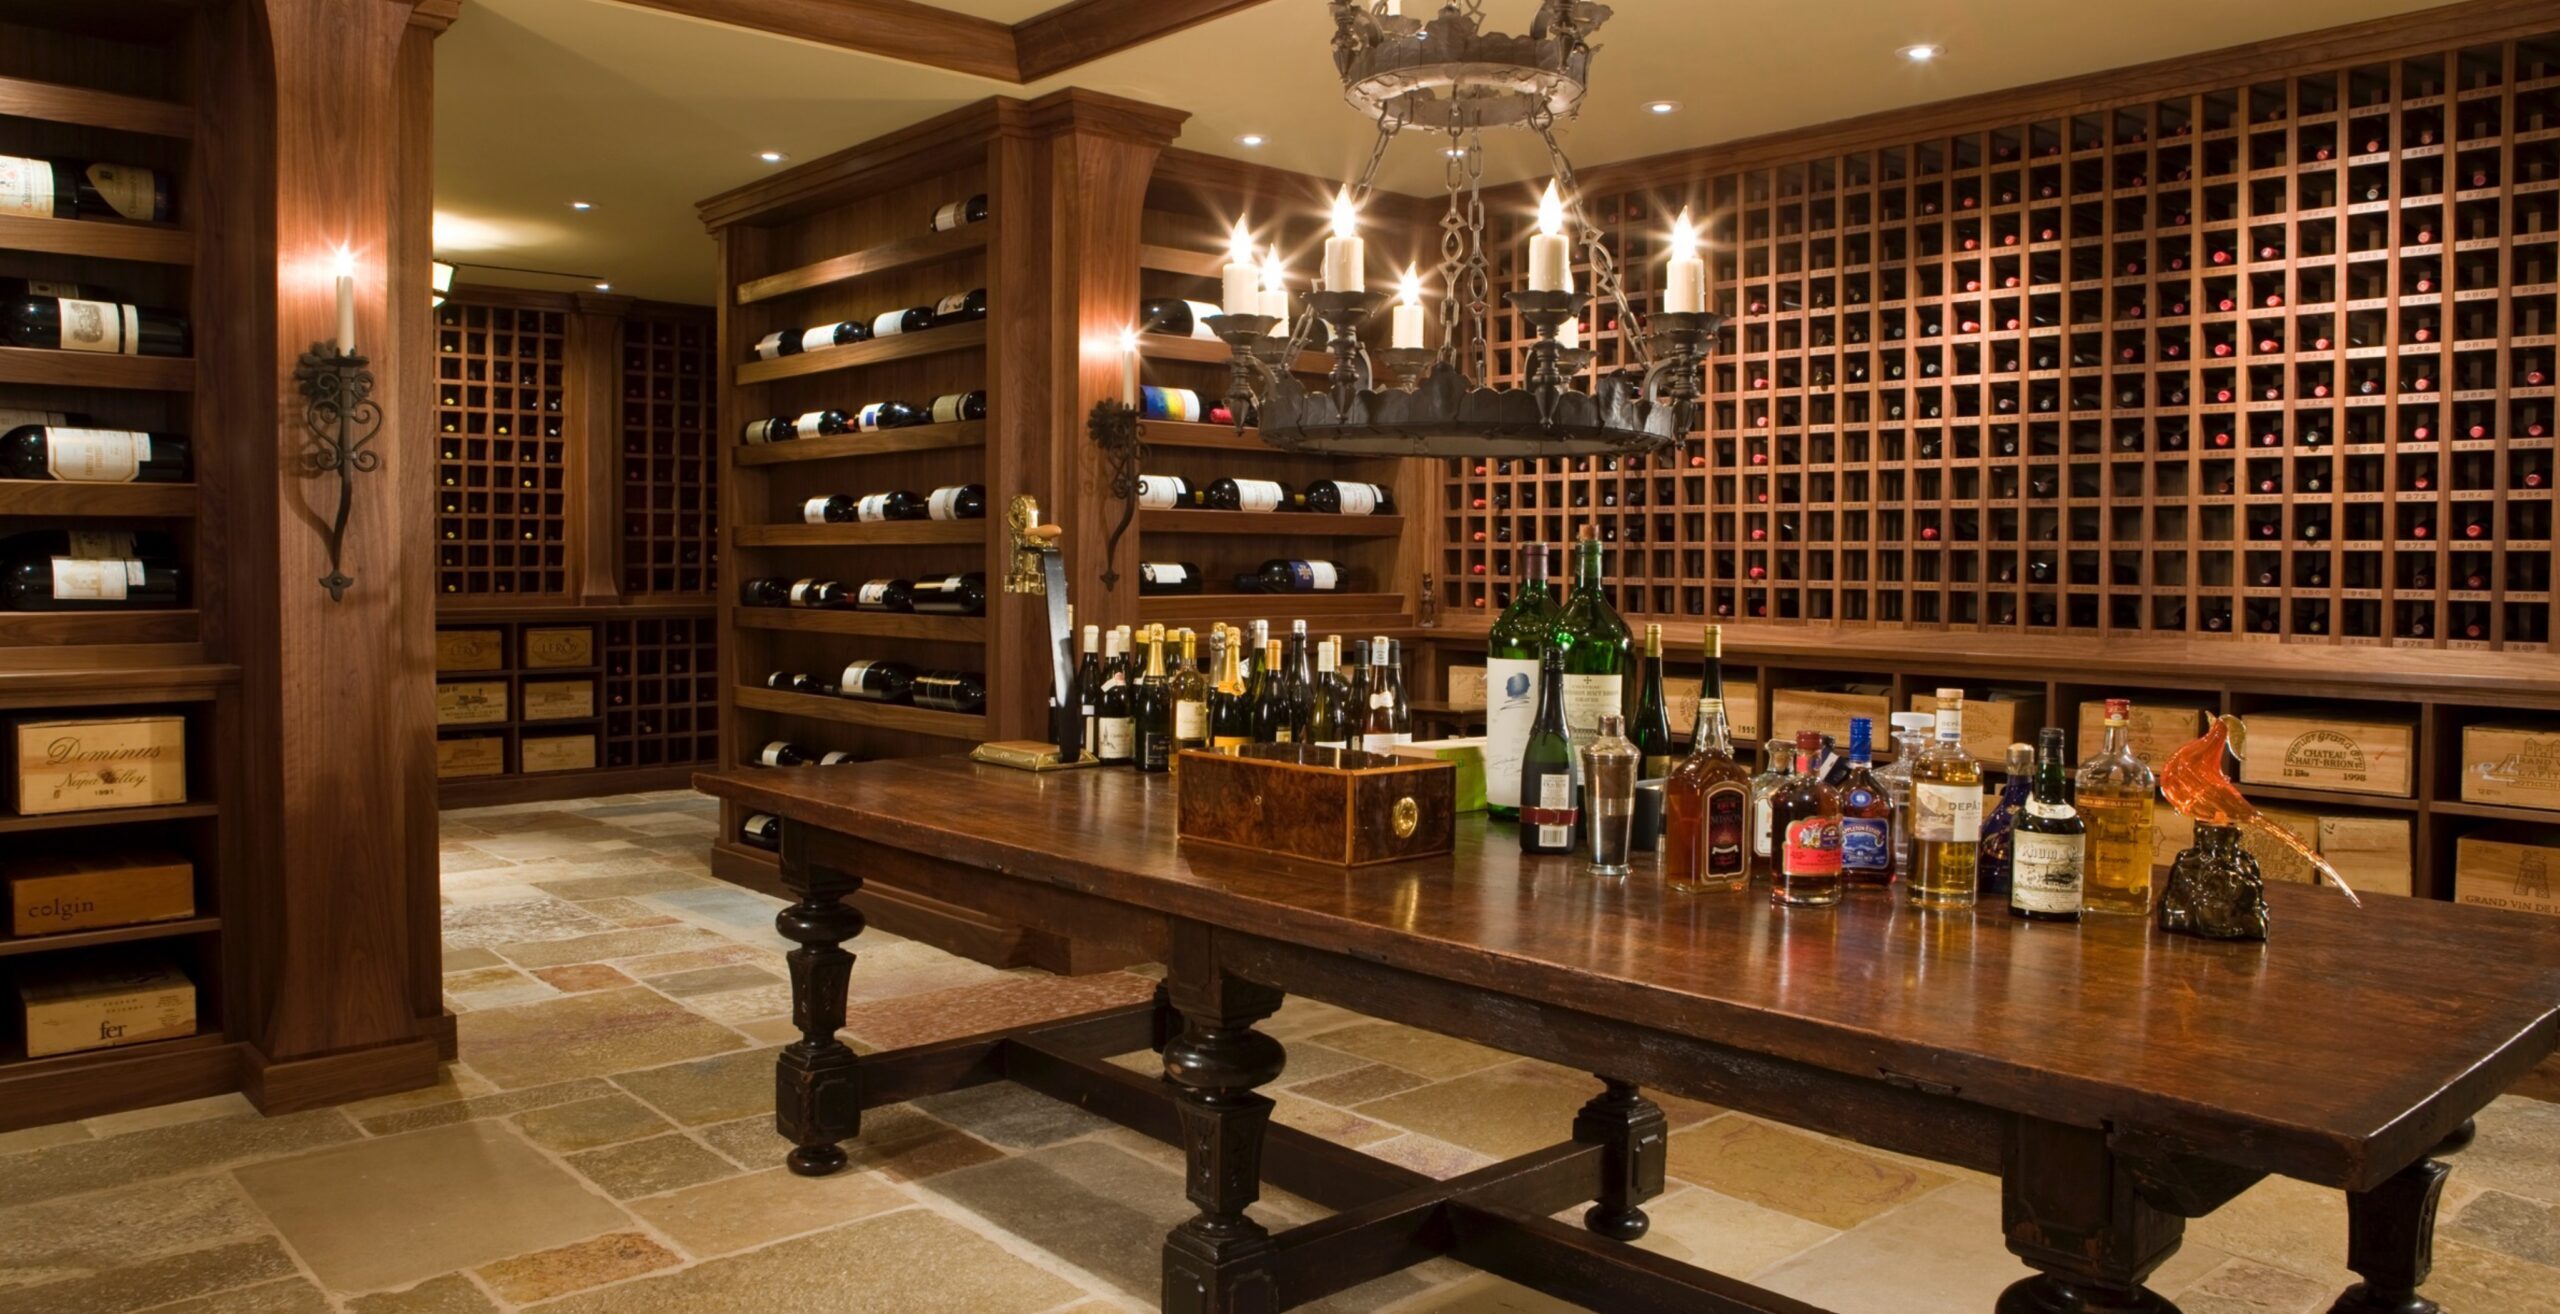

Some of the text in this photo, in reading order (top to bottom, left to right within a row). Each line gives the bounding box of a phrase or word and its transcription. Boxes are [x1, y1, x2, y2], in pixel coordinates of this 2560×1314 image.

[542, 637, 577, 654] LEROY
[1737, 724, 1756, 734] 1990
[46, 736, 161, 765] Dominus
[2304, 749, 2347, 759] CHATEAU
[2295, 757, 2354, 768] HAUT-BRION
[54, 771, 98, 790] Napa
[28, 897, 94, 920] colgin
[2465, 895, 2507, 907] GRAND
[2510, 899, 2532, 910] VIN
[2536, 903, 2551, 913] DE
[99, 1021, 128, 1040] fer
